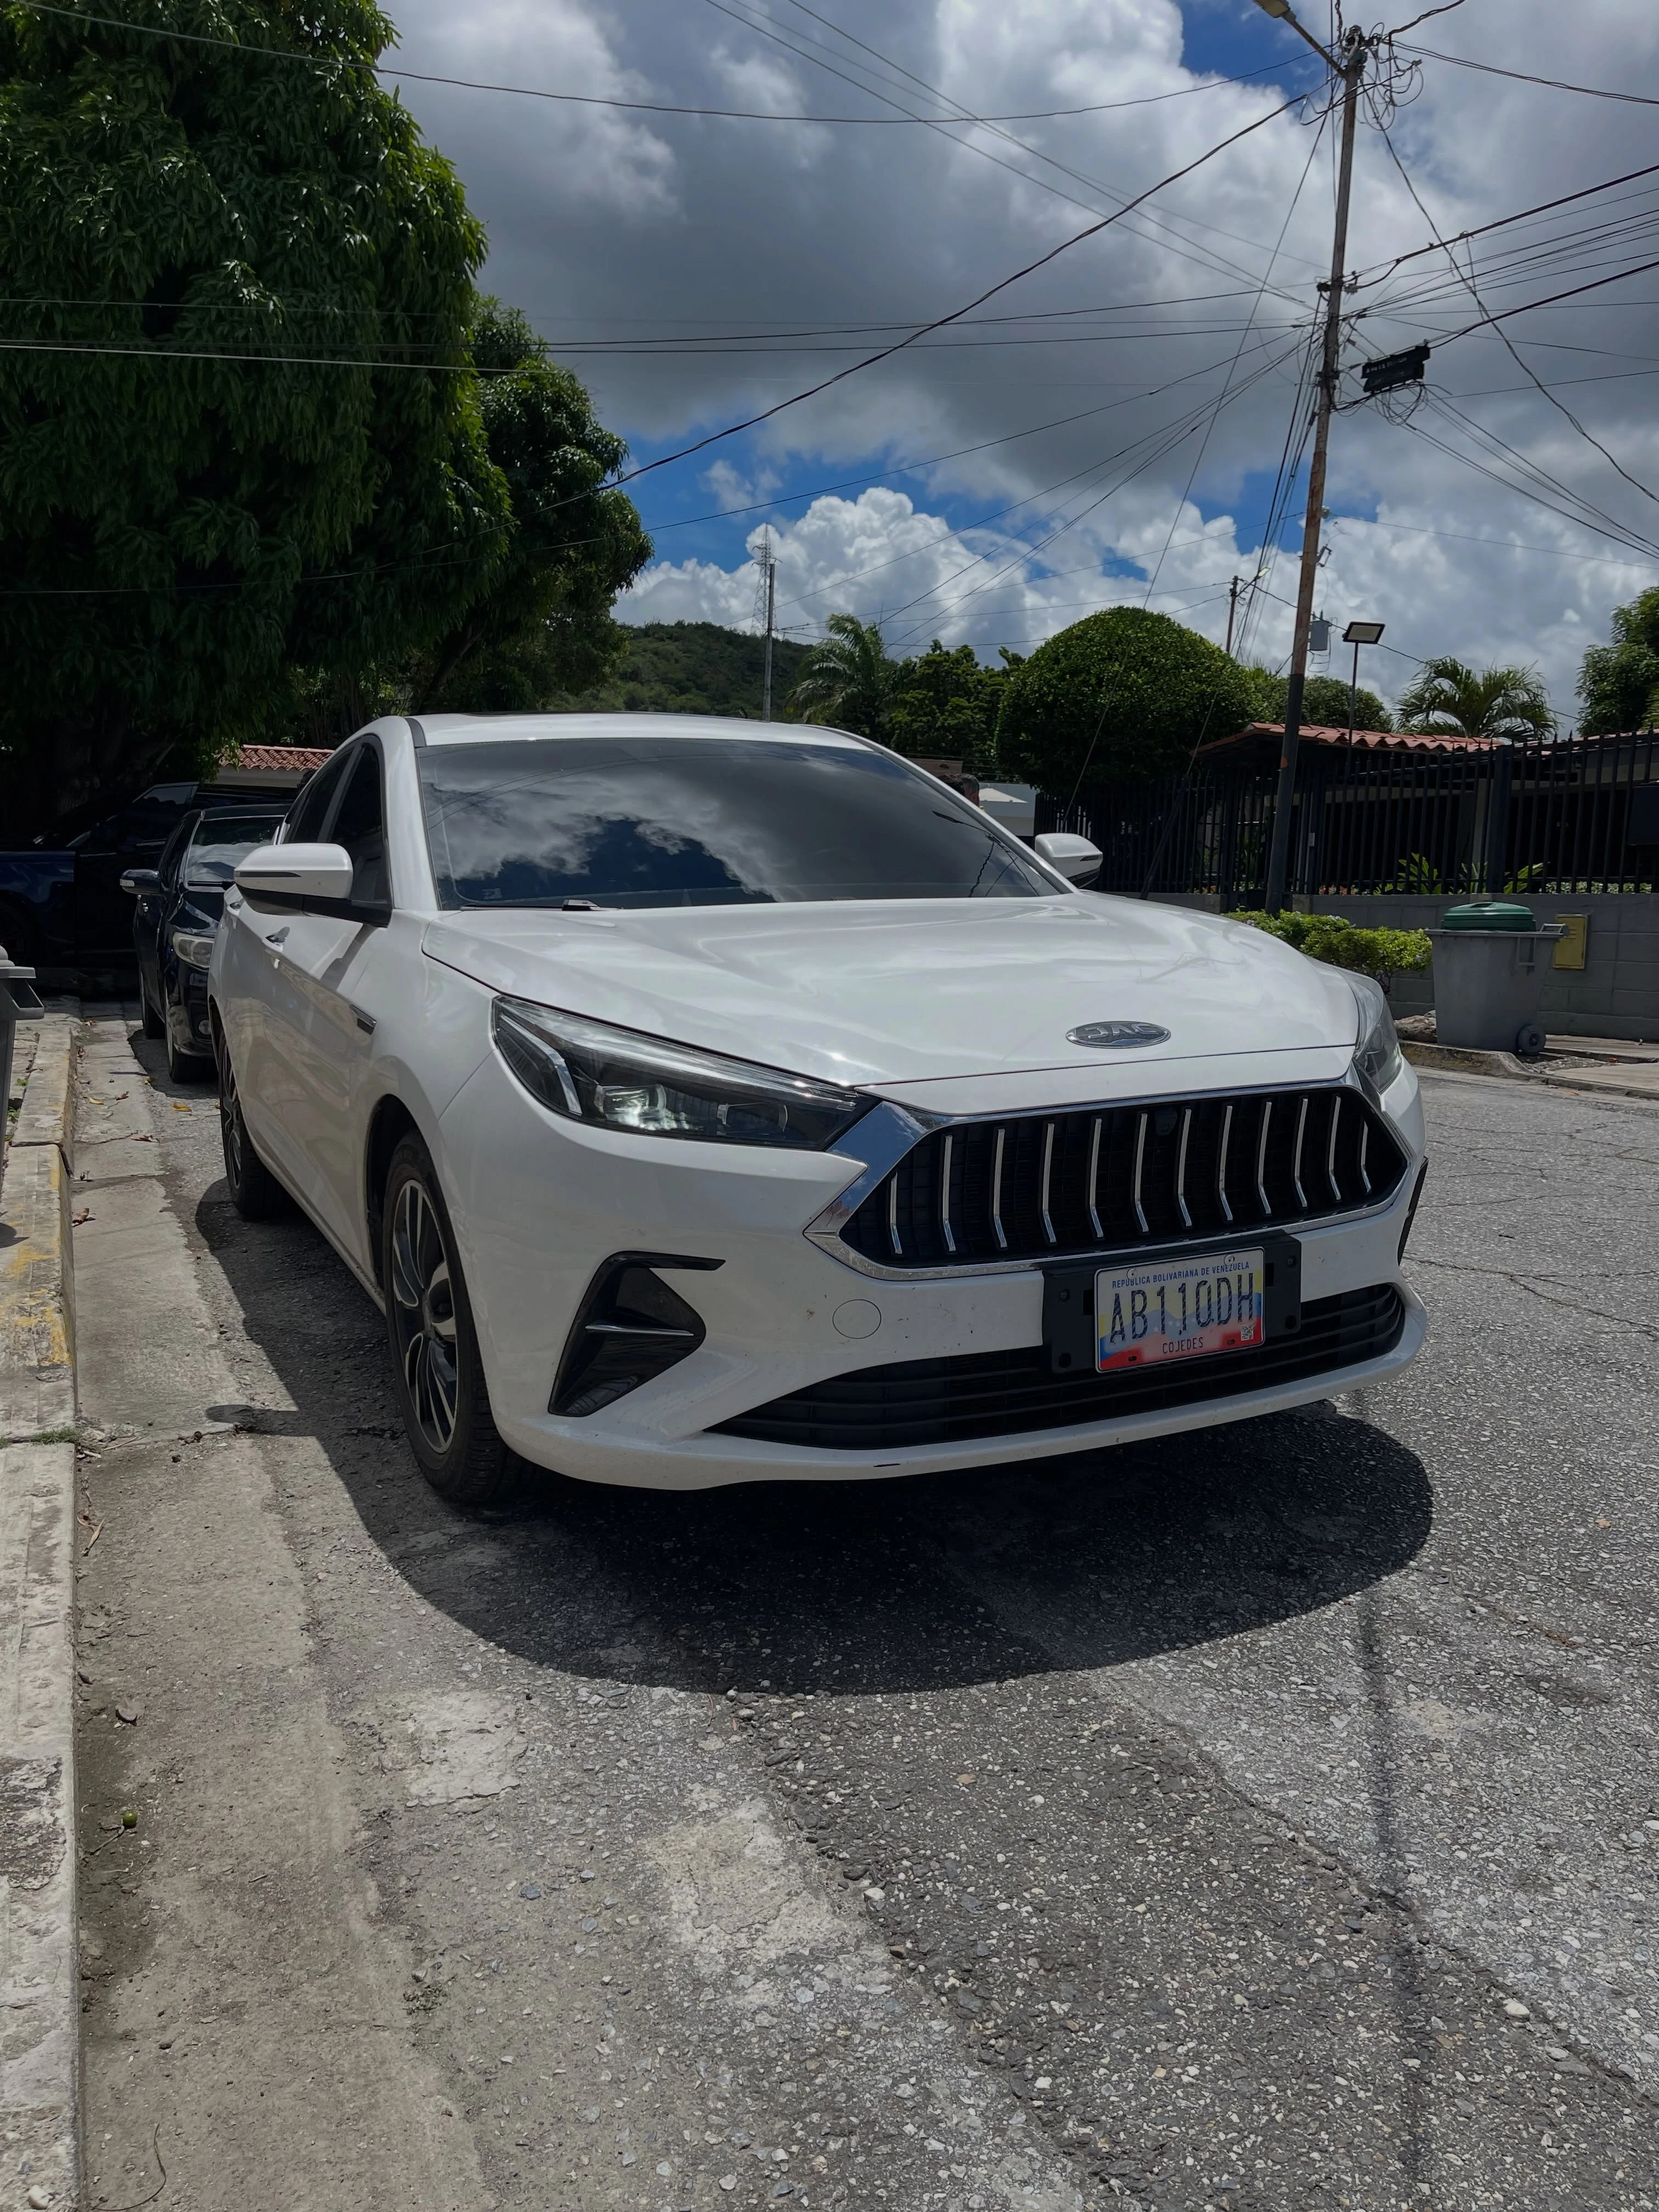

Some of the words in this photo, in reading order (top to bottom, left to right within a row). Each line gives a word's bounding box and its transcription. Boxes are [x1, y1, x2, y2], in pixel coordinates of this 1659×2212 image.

[1153, 1268, 1198, 1283] BOLIVARIANA
[1201, 1267, 1210, 1276] DE
[1212, 1261, 1250, 1274] VENEZUELA
[1162, 1336, 1204, 1354] COJEDES
